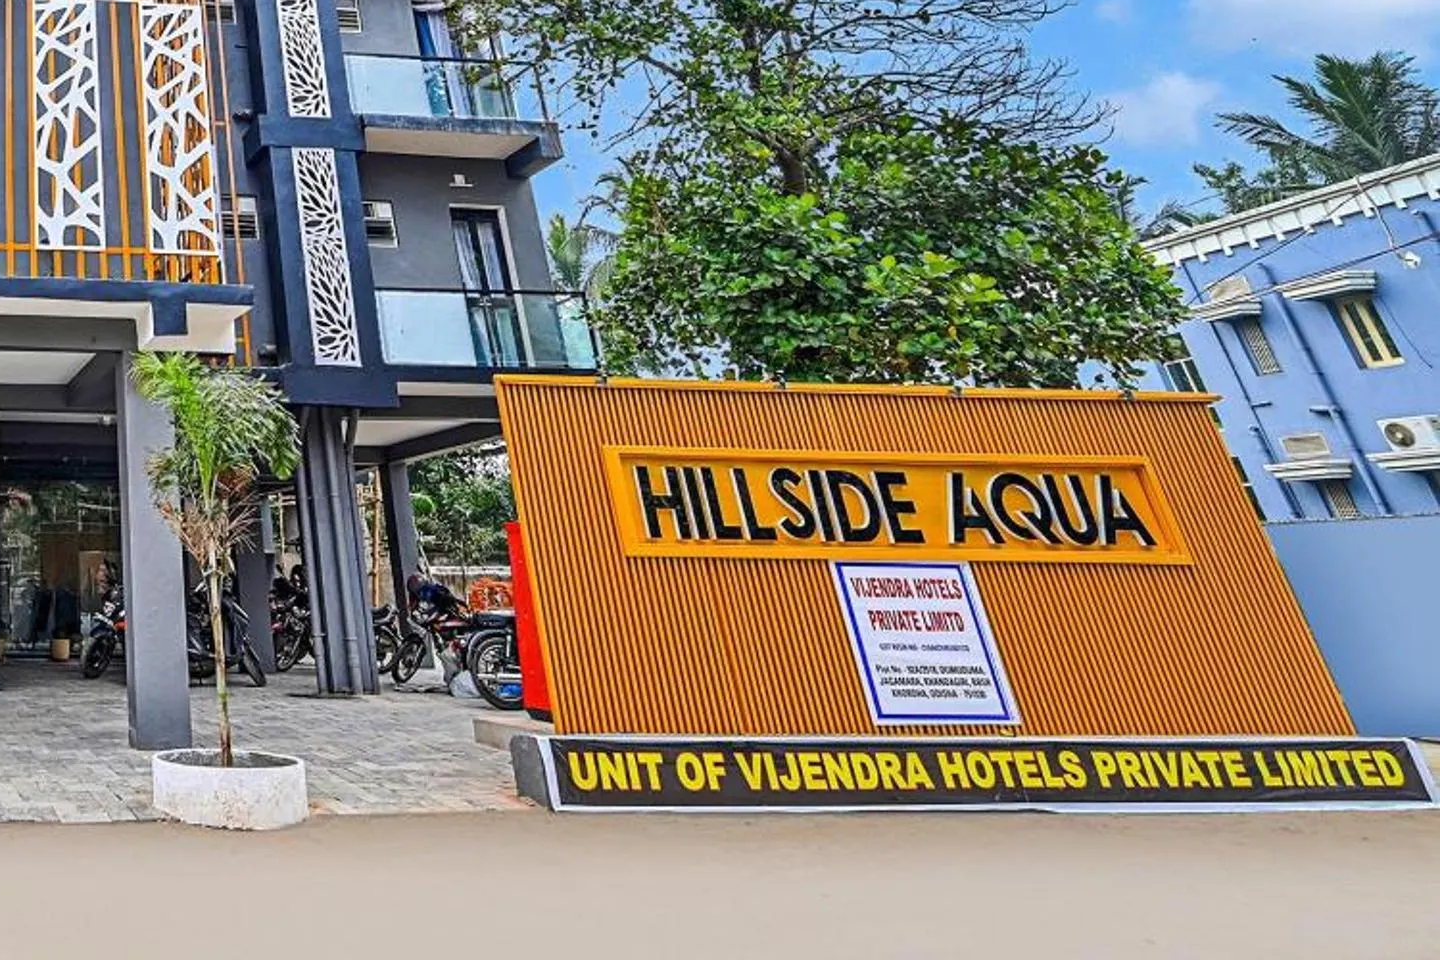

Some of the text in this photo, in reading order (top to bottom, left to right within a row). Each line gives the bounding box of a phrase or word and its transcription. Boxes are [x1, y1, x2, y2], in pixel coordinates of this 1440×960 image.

[632, 465, 1158, 547] HILLSIDE AQUA
[850, 577, 963, 600] VIJENDRA HOTELS
[868, 610, 965, 632] PRIVATE LIMITD
[568, 750, 1405, 791] UNIT OF VIJENDRA HOTELS PRIVATE LIMITED
